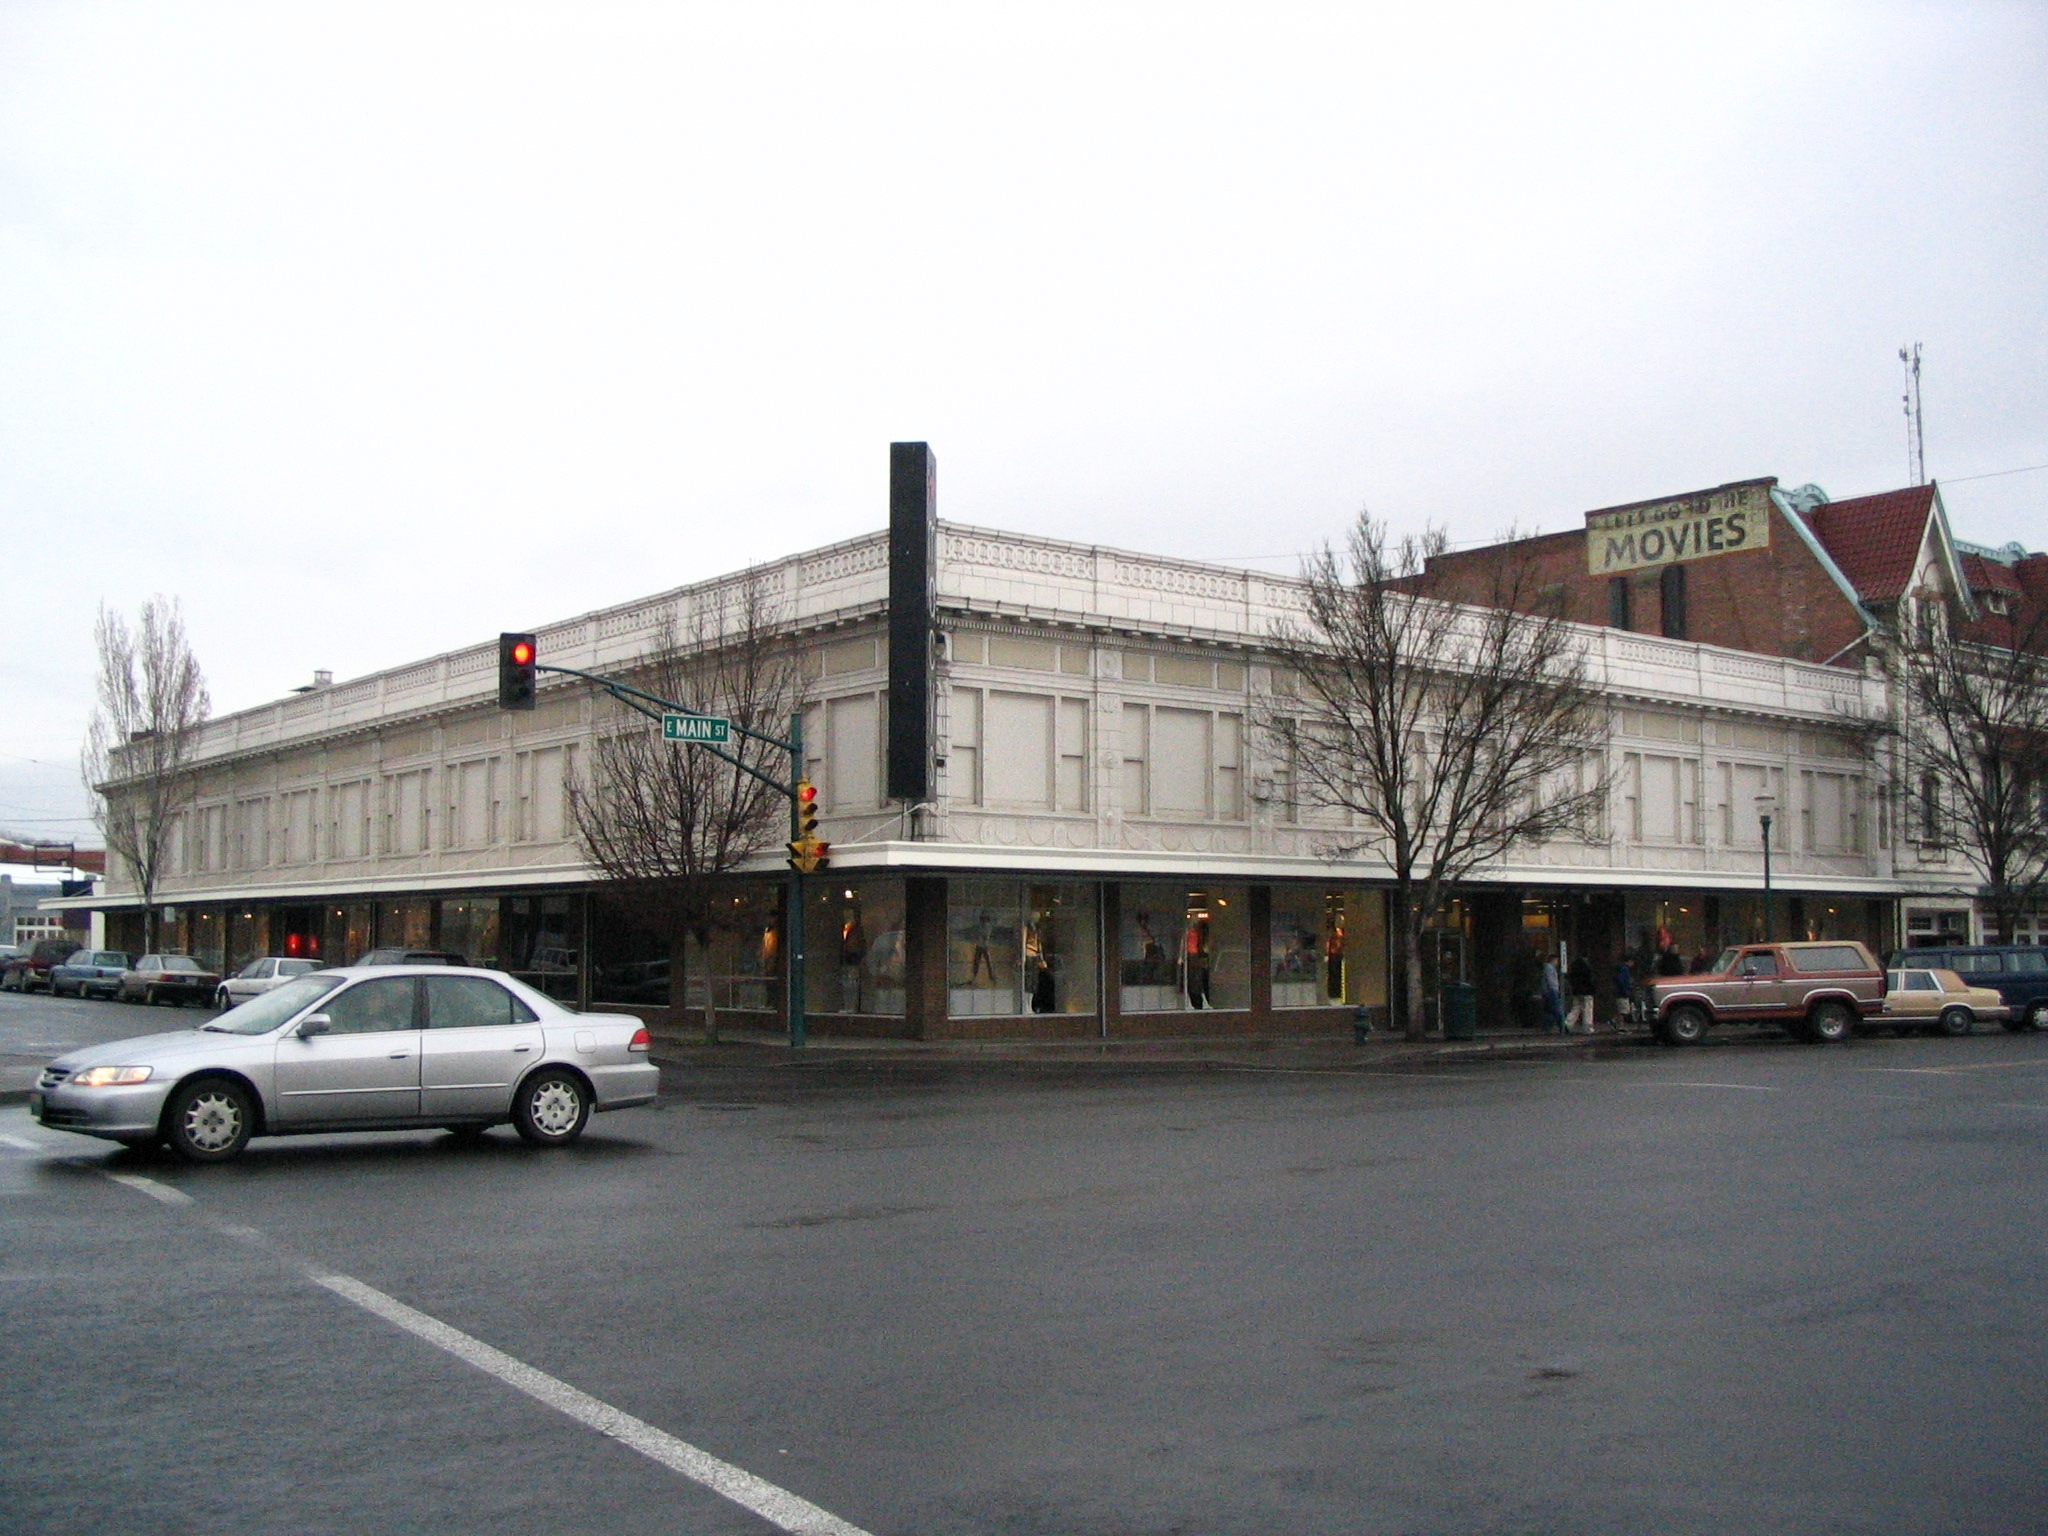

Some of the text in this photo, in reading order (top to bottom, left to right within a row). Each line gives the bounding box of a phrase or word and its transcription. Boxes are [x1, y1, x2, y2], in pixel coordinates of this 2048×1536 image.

[1603, 513, 1747, 569] MOVIES
[666, 718, 725, 738] E MAIN ST
